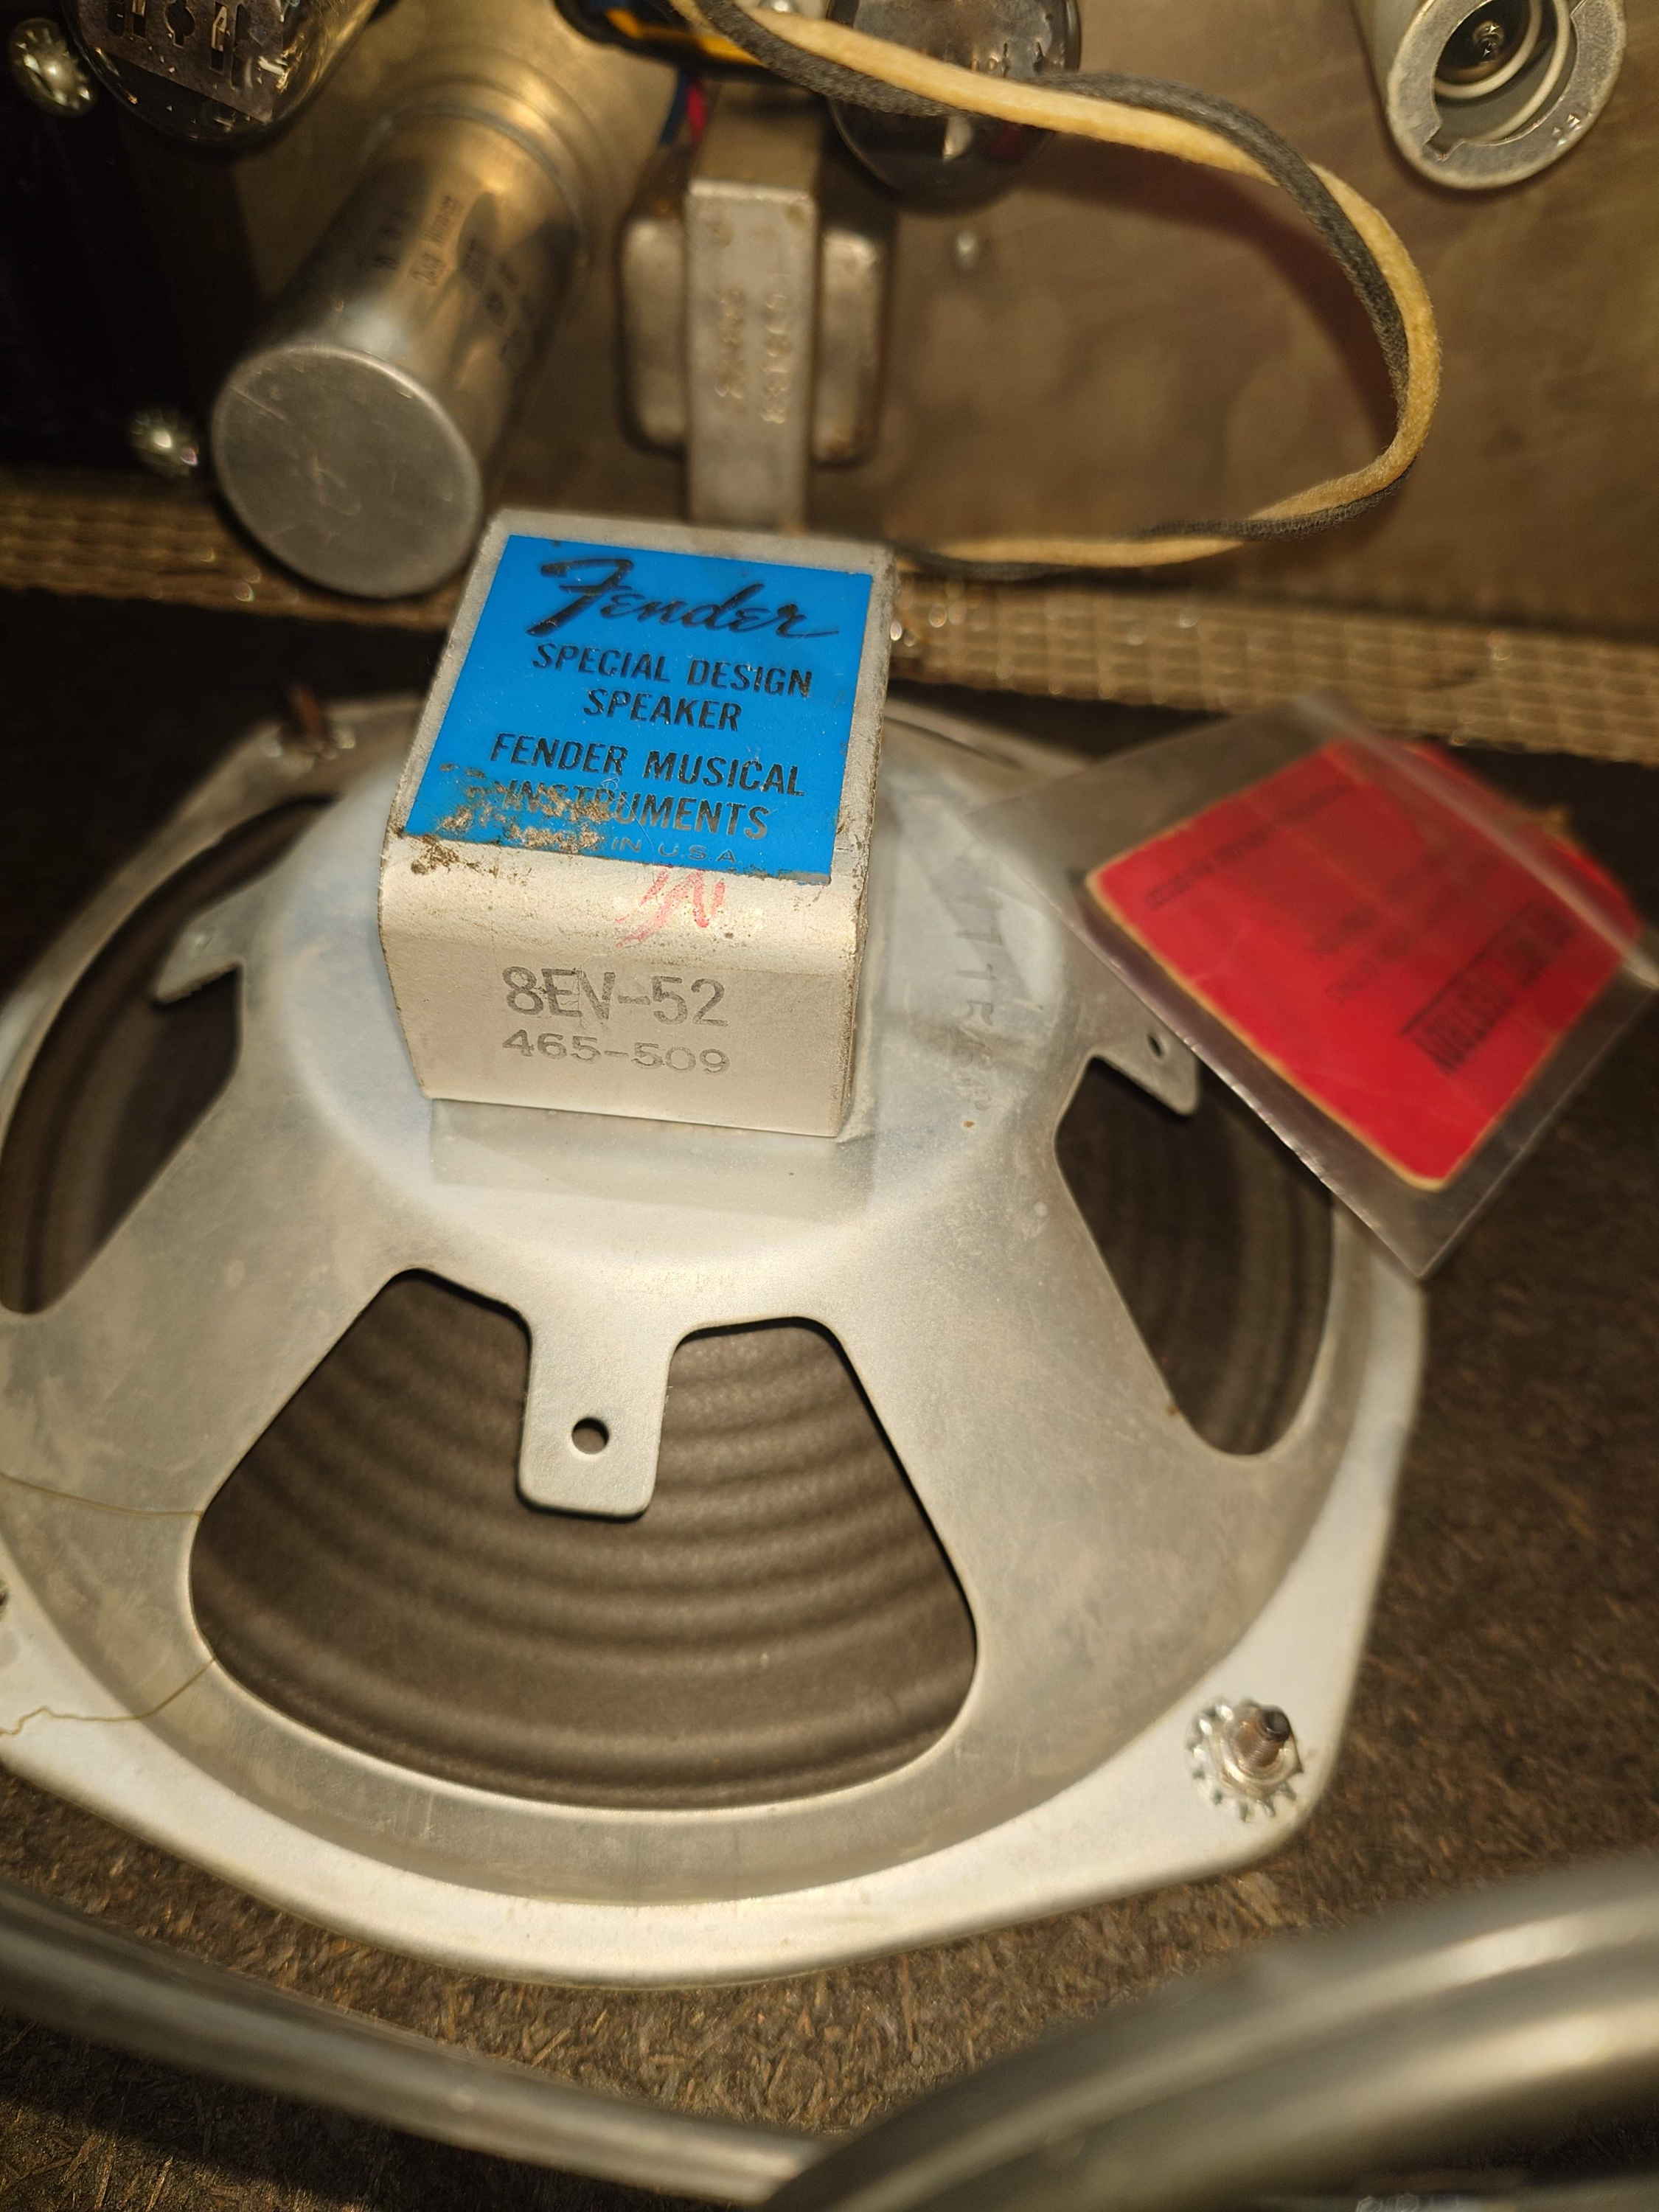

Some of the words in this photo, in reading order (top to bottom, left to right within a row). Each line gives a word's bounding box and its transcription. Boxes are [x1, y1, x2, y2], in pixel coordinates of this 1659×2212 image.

[526, 558, 838, 638] Fender
[532, 643, 671, 682] SPECIAL
[687, 658, 813, 697] DESIGN
[583, 688, 742, 732] SPEAKER
[490, 732, 627, 776] FENDER
[643, 750, 805, 796] MUSICAL
[501, 779, 770, 839] INSTRUMENTS
[611, 836, 641, 852] IN
[502, 966, 728, 1027] 8EV-52
[501, 1029, 730, 1074] 465-509
